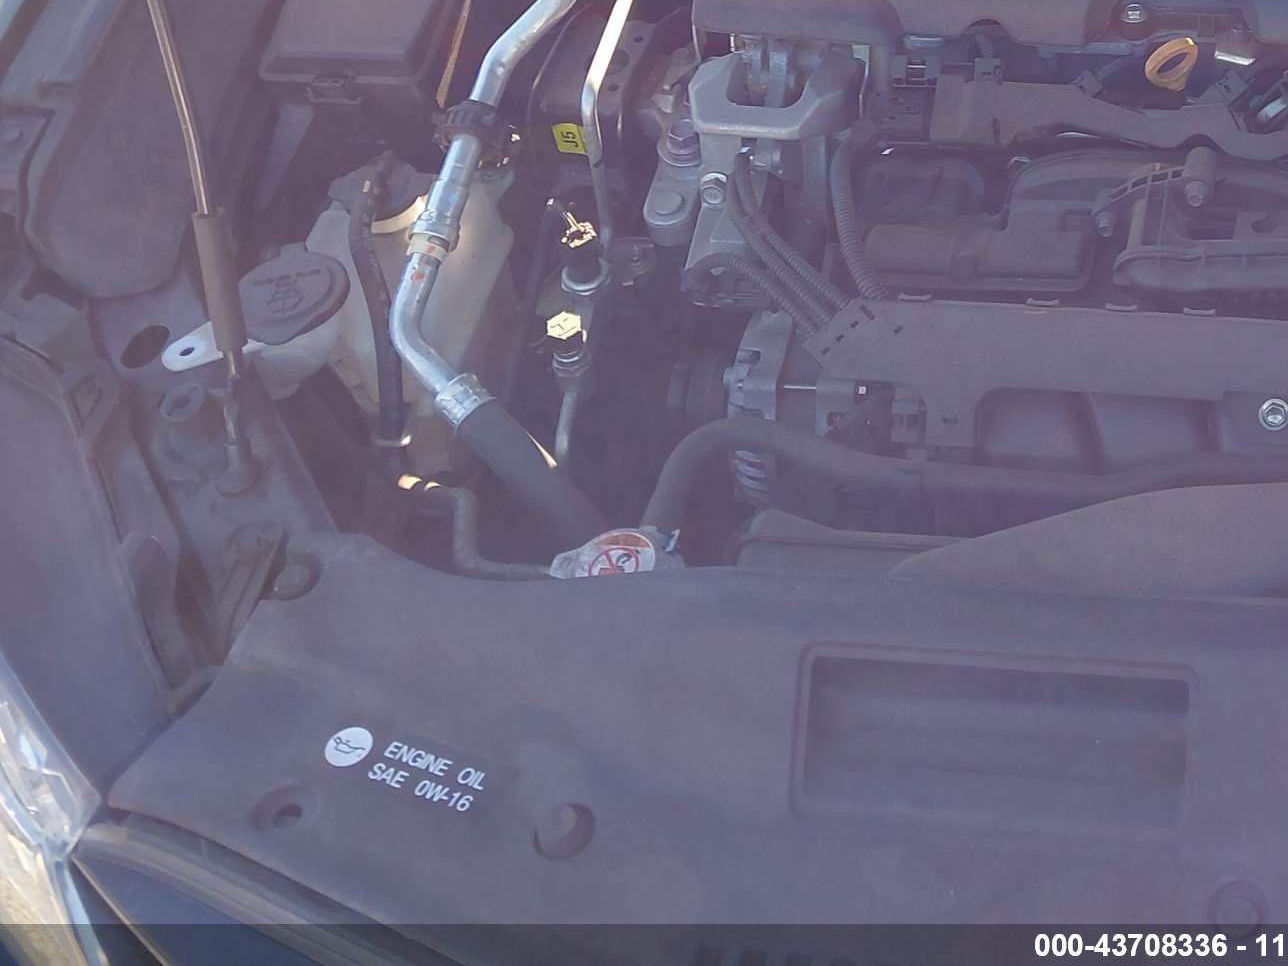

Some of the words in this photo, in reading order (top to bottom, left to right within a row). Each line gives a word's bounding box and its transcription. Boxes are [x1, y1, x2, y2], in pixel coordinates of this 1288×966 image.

[560, 131, 579, 148] J5
[368, 763, 409, 788] SAE
[414, 780, 474, 811] 0W-16
[384, 742, 452, 776] ENGINE
[458, 768, 487, 790] OIL
